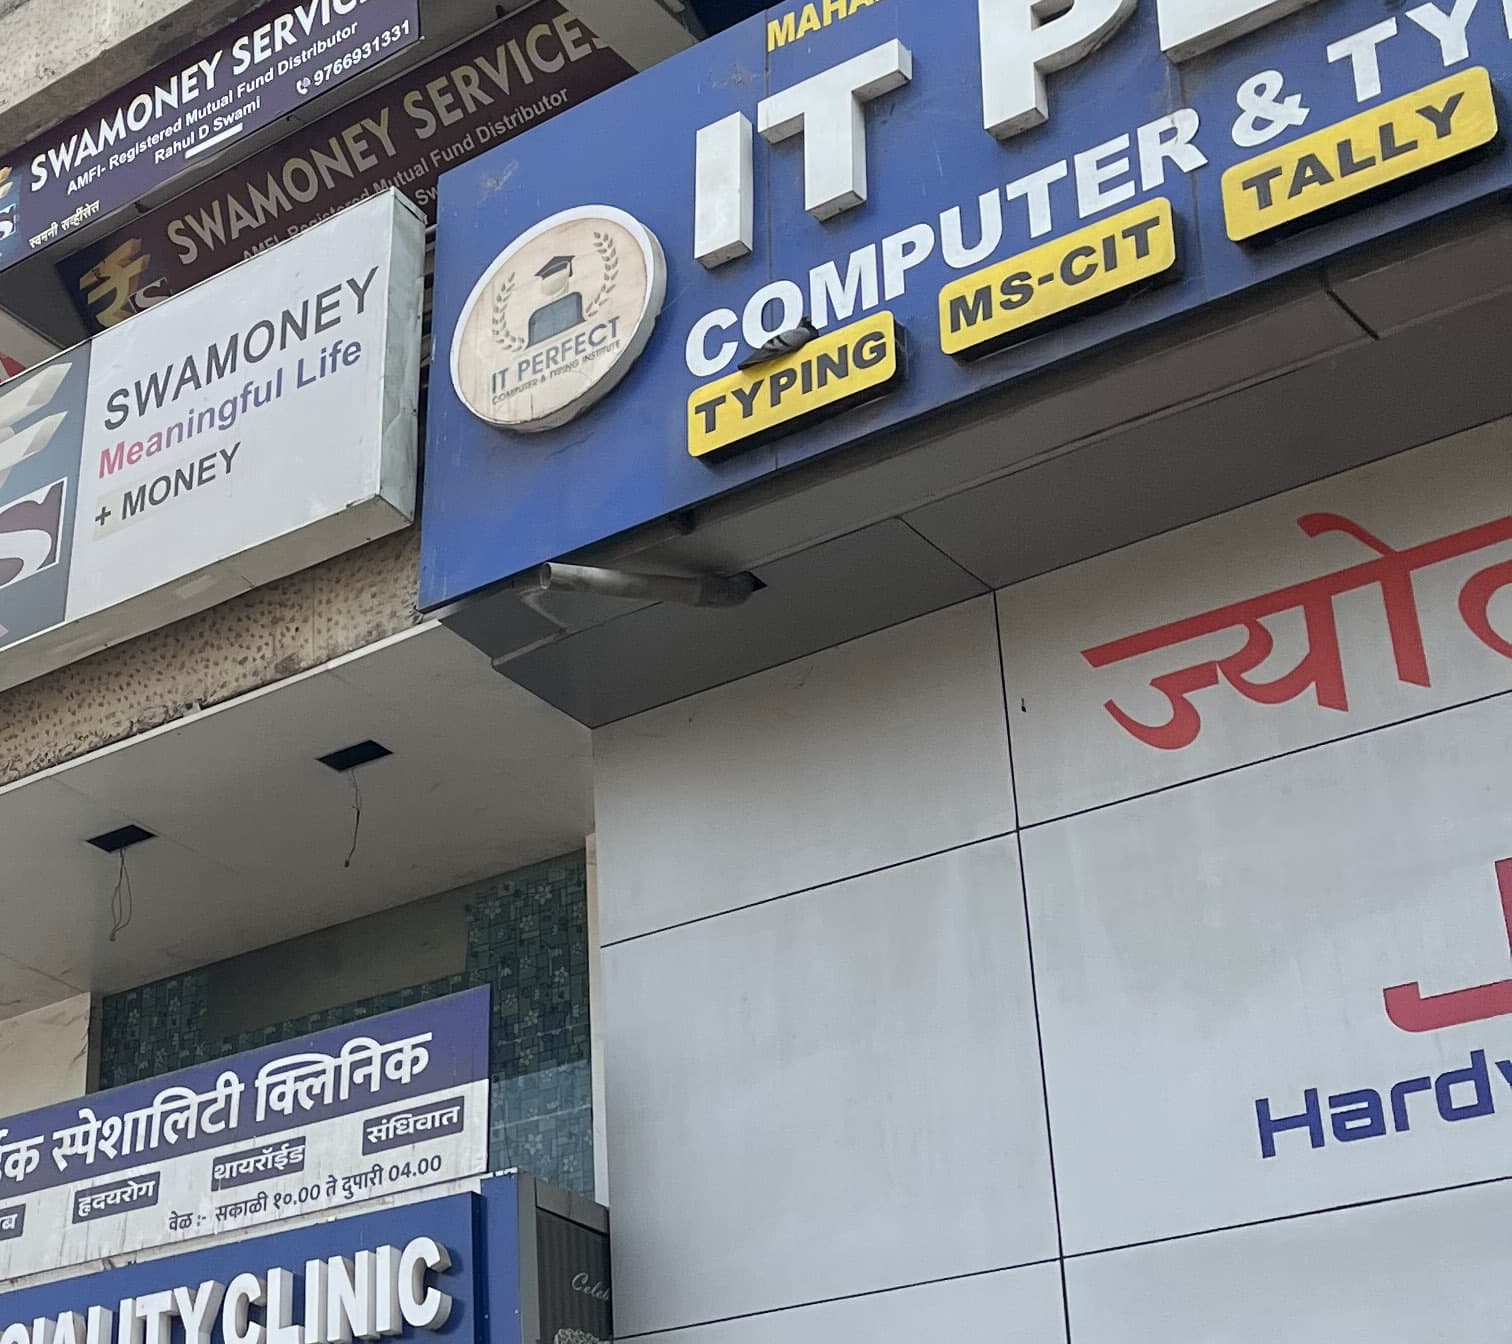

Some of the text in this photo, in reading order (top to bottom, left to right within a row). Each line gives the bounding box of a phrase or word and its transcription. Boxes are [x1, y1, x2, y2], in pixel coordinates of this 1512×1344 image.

[313, 19, 411, 87] 9766931331
[30, 50, 223, 192] SWAMONEY
[67, 21, 358, 195] AMFI- Registered Mutual Fund Distributor
[154, 96, 261, 165] Rahul Swami
[432, 89, 570, 167] Fund Distributor
[694, 36, 912, 268] IT
[1242, 92, 1465, 210] TALLY
[168, 106, 396, 265] SWAMONEY
[686, 106, 1208, 377] COMPUTER
[1231, 70, 1310, 147] &
[949, 216, 1163, 334] MS-CIT
[104, 266, 379, 431] SWAMONEY
[492, 315, 621, 395] IT PERFECT
[695, 332, 887, 433] TYPING
[98, 337, 362, 478] Meaningful Life
[121, 443, 241, 520] MONEY
[50, 1070, 245, 1173] स्पेशालिटी
[255, 1031, 433, 1123] क्लिनिक
[366, 1105, 462, 1144] संधिवात
[77, 1180, 156, 1218] हृदयरोग
[169, 1155, 442, 1232] वेळ सकाळी दुपारी 04.00
[213, 1143, 306, 1182] थायरॉईड
